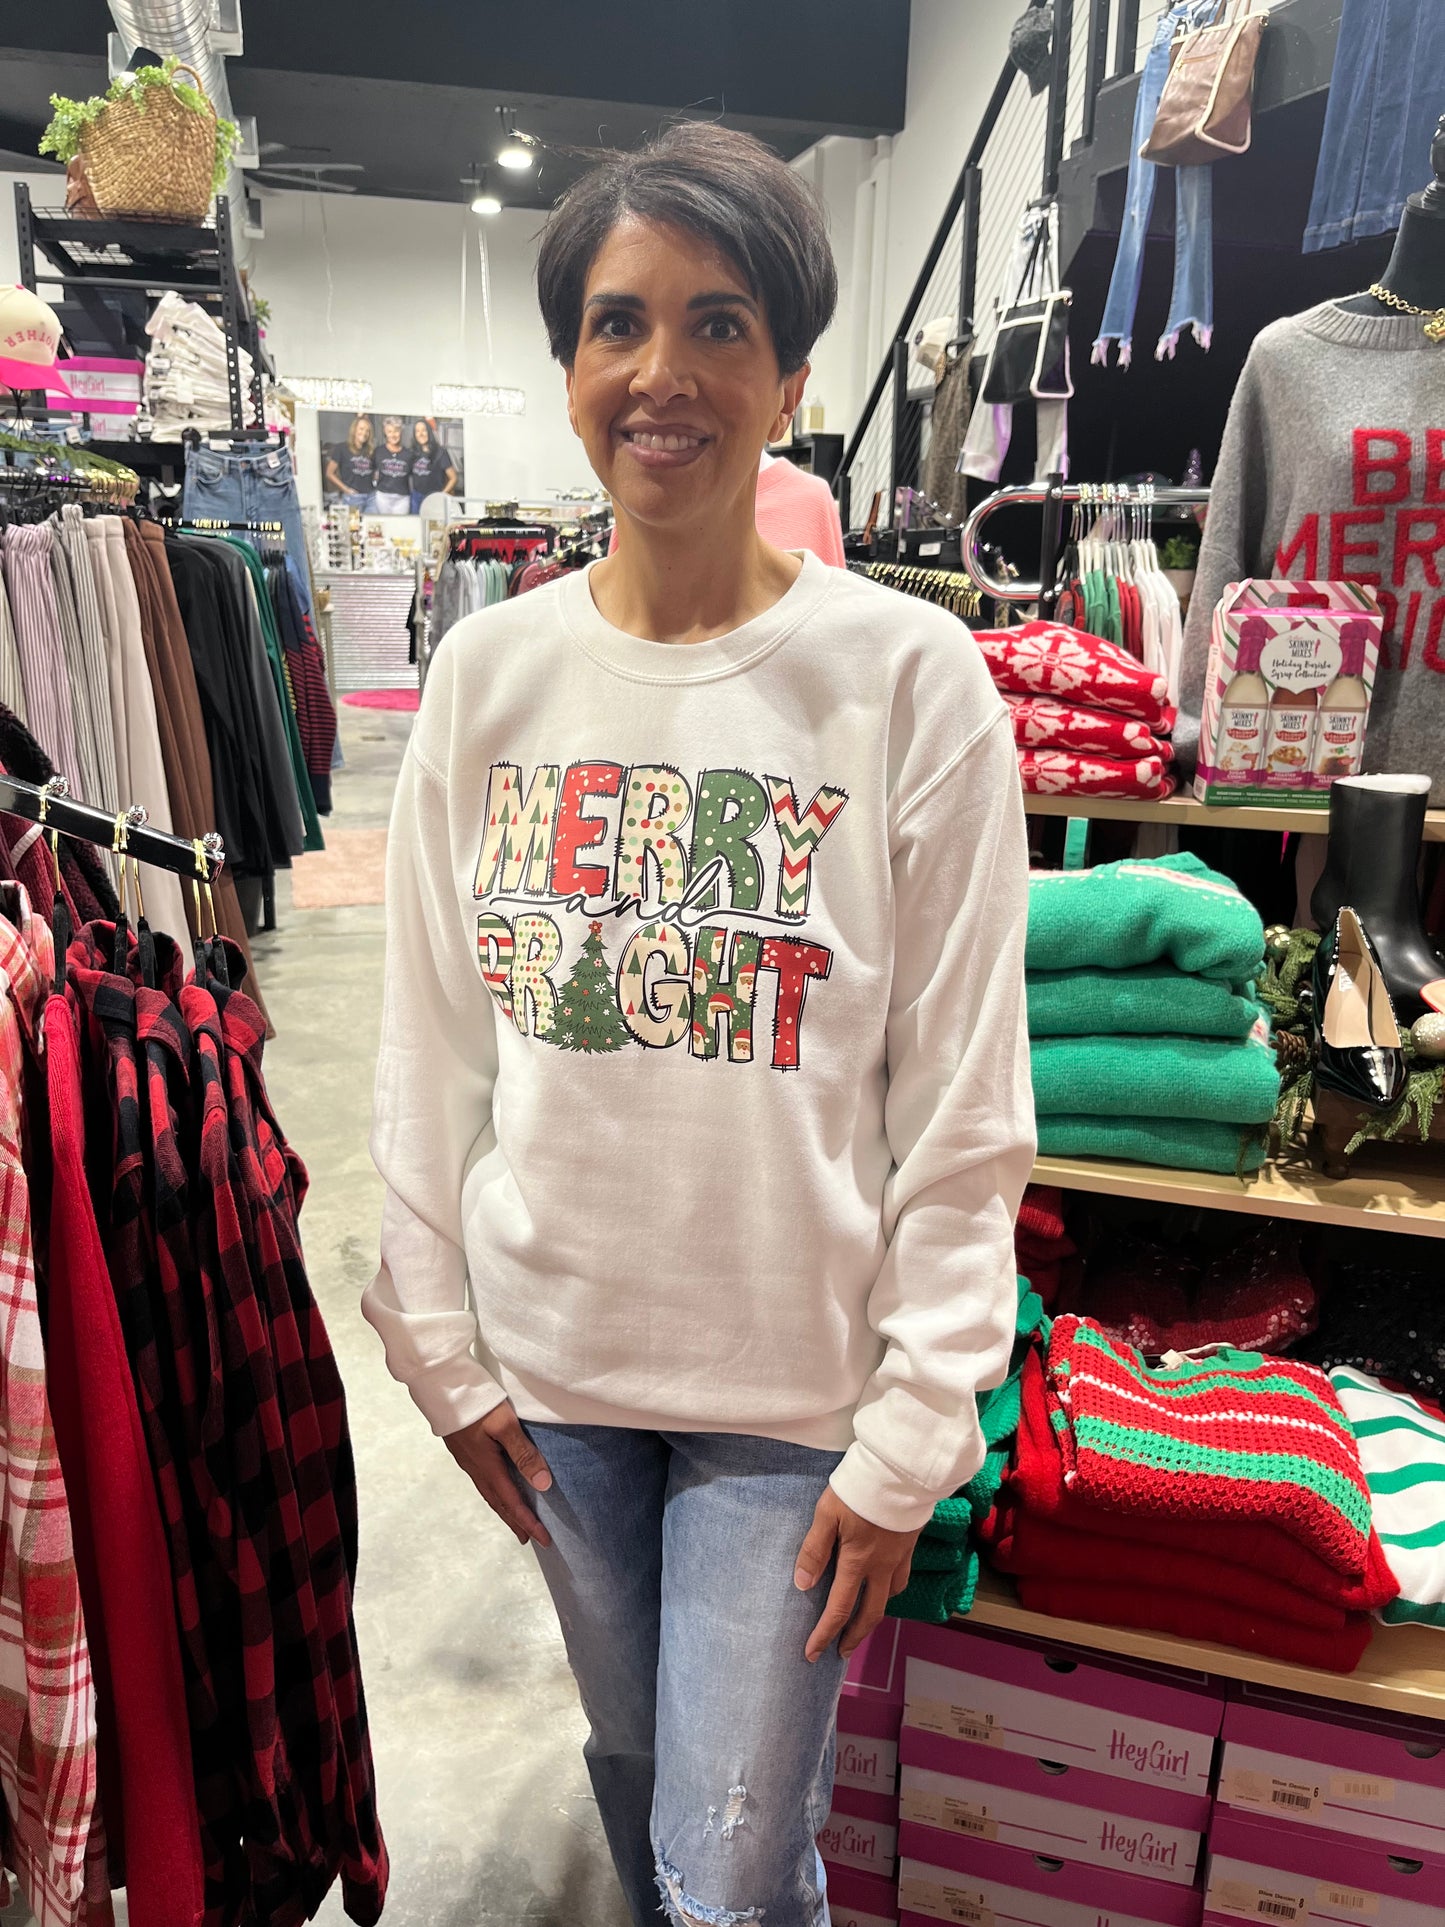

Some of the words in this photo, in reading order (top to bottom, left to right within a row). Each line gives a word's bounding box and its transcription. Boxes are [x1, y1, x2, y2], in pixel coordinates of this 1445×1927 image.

[1288, 640, 1314, 649] SKINNY
[1291, 649, 1312, 658] MIXES
[1272, 659, 1302, 671] Holiday
[1304, 660, 1331, 670] Barista
[1271, 669, 1293, 680] Syrup
[1295, 669, 1327, 679] Collection
[1231, 712, 1253, 720] SKINNY
[1280, 714, 1302, 722] SKINNY
[1329, 716, 1352, 724] SKINNY
[473, 760, 850, 917] MERRY
[490, 856, 807, 928] and
[1313, 1787, 1319, 1798] 6
[817, 1825, 876, 1858] eyGirl
